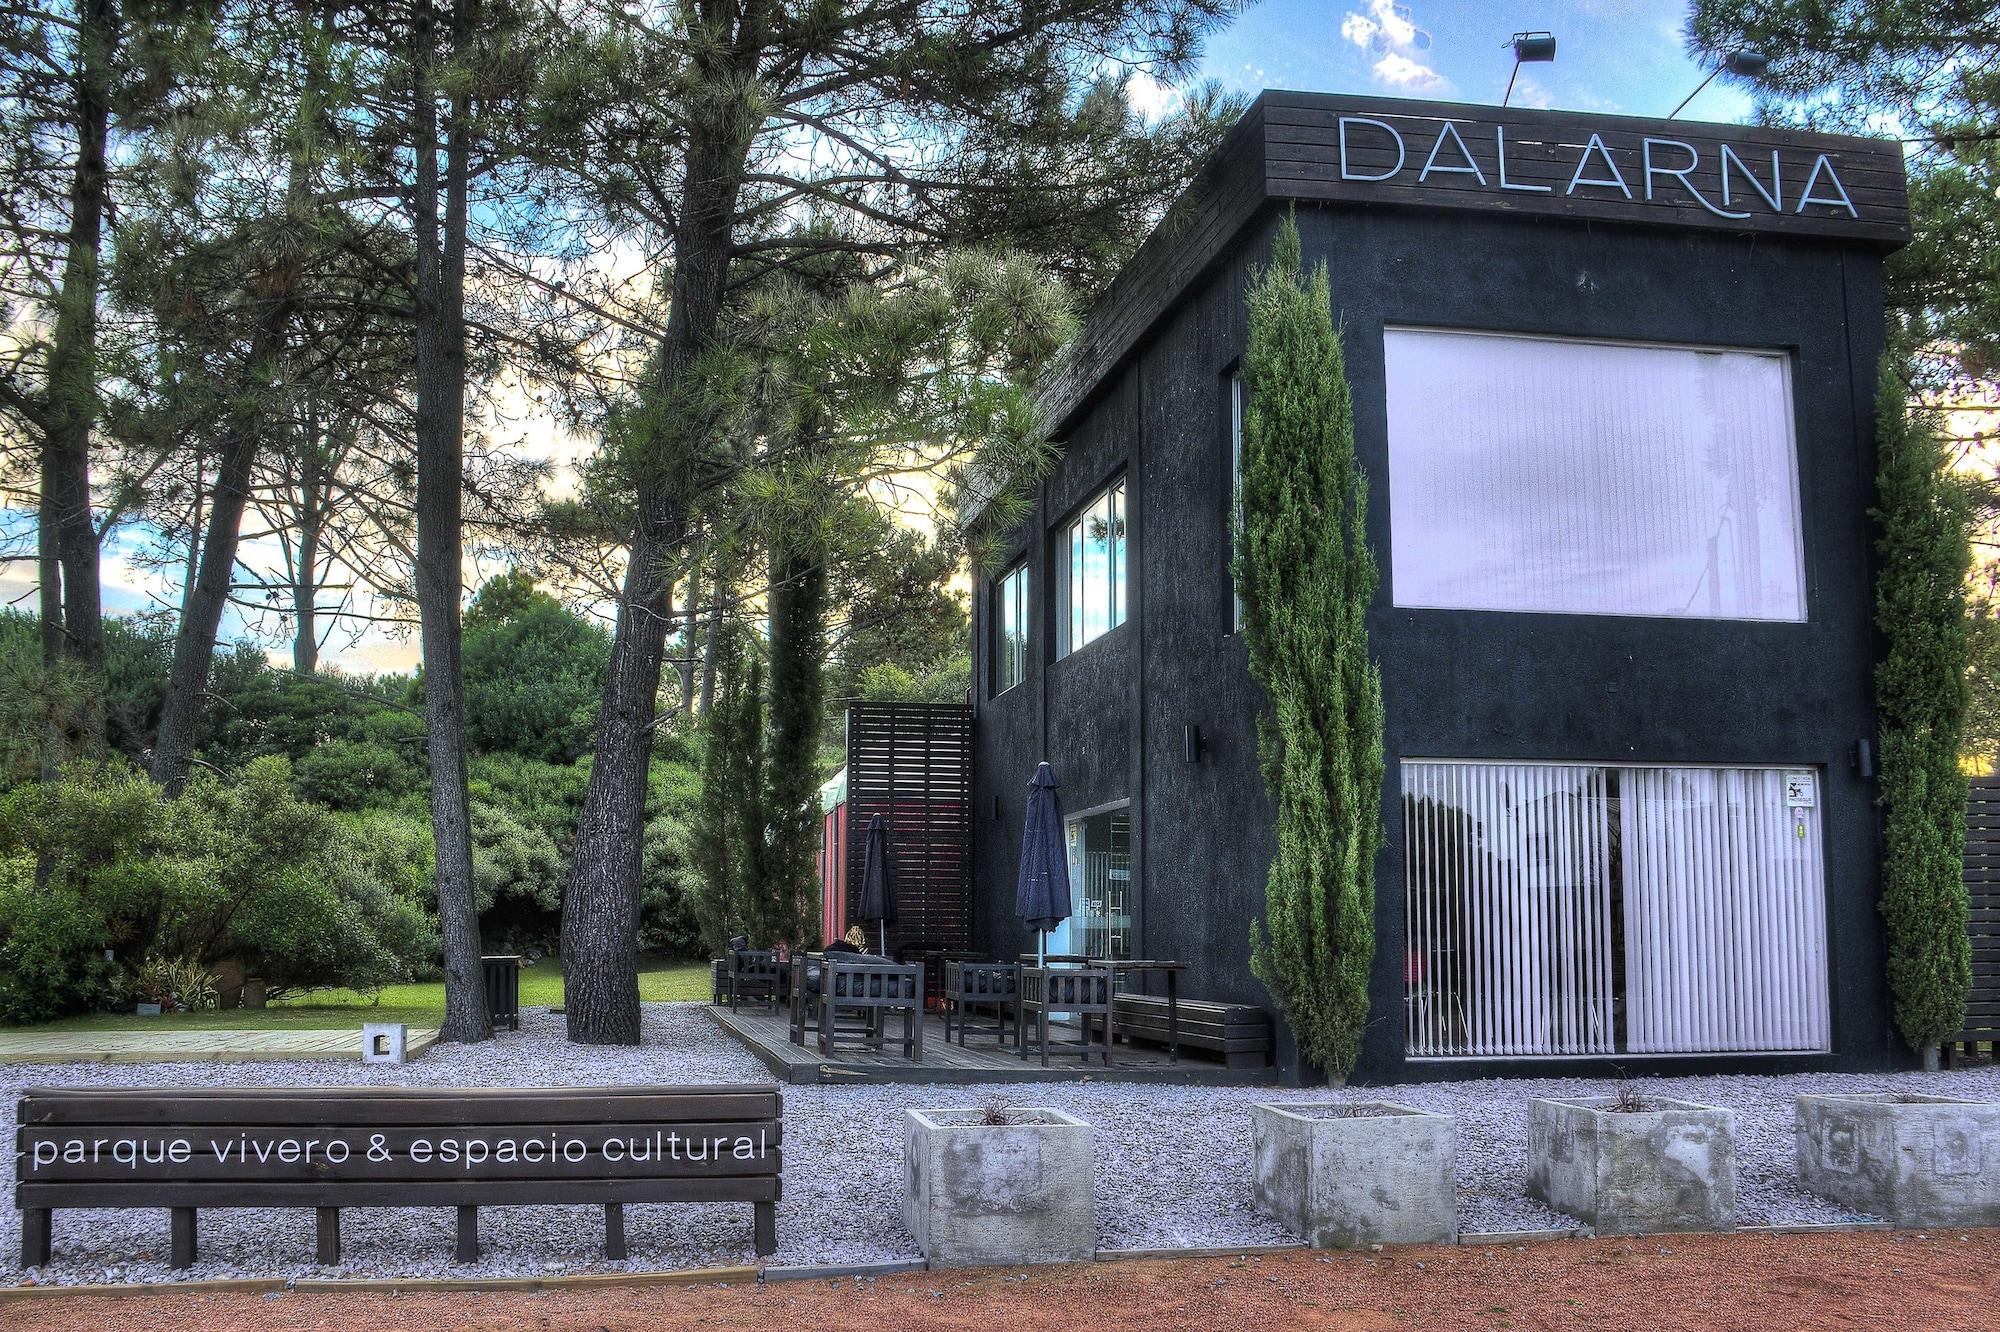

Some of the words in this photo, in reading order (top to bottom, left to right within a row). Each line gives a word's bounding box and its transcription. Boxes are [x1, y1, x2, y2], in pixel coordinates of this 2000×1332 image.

[1338, 116, 1859, 220] DALARNA
[33, 1139, 193, 1170] parque
[210, 1132, 350, 1164] vivero
[366, 1133, 393, 1162] &
[409, 1132, 587, 1169] espacio
[602, 1128, 767, 1162] cultural
